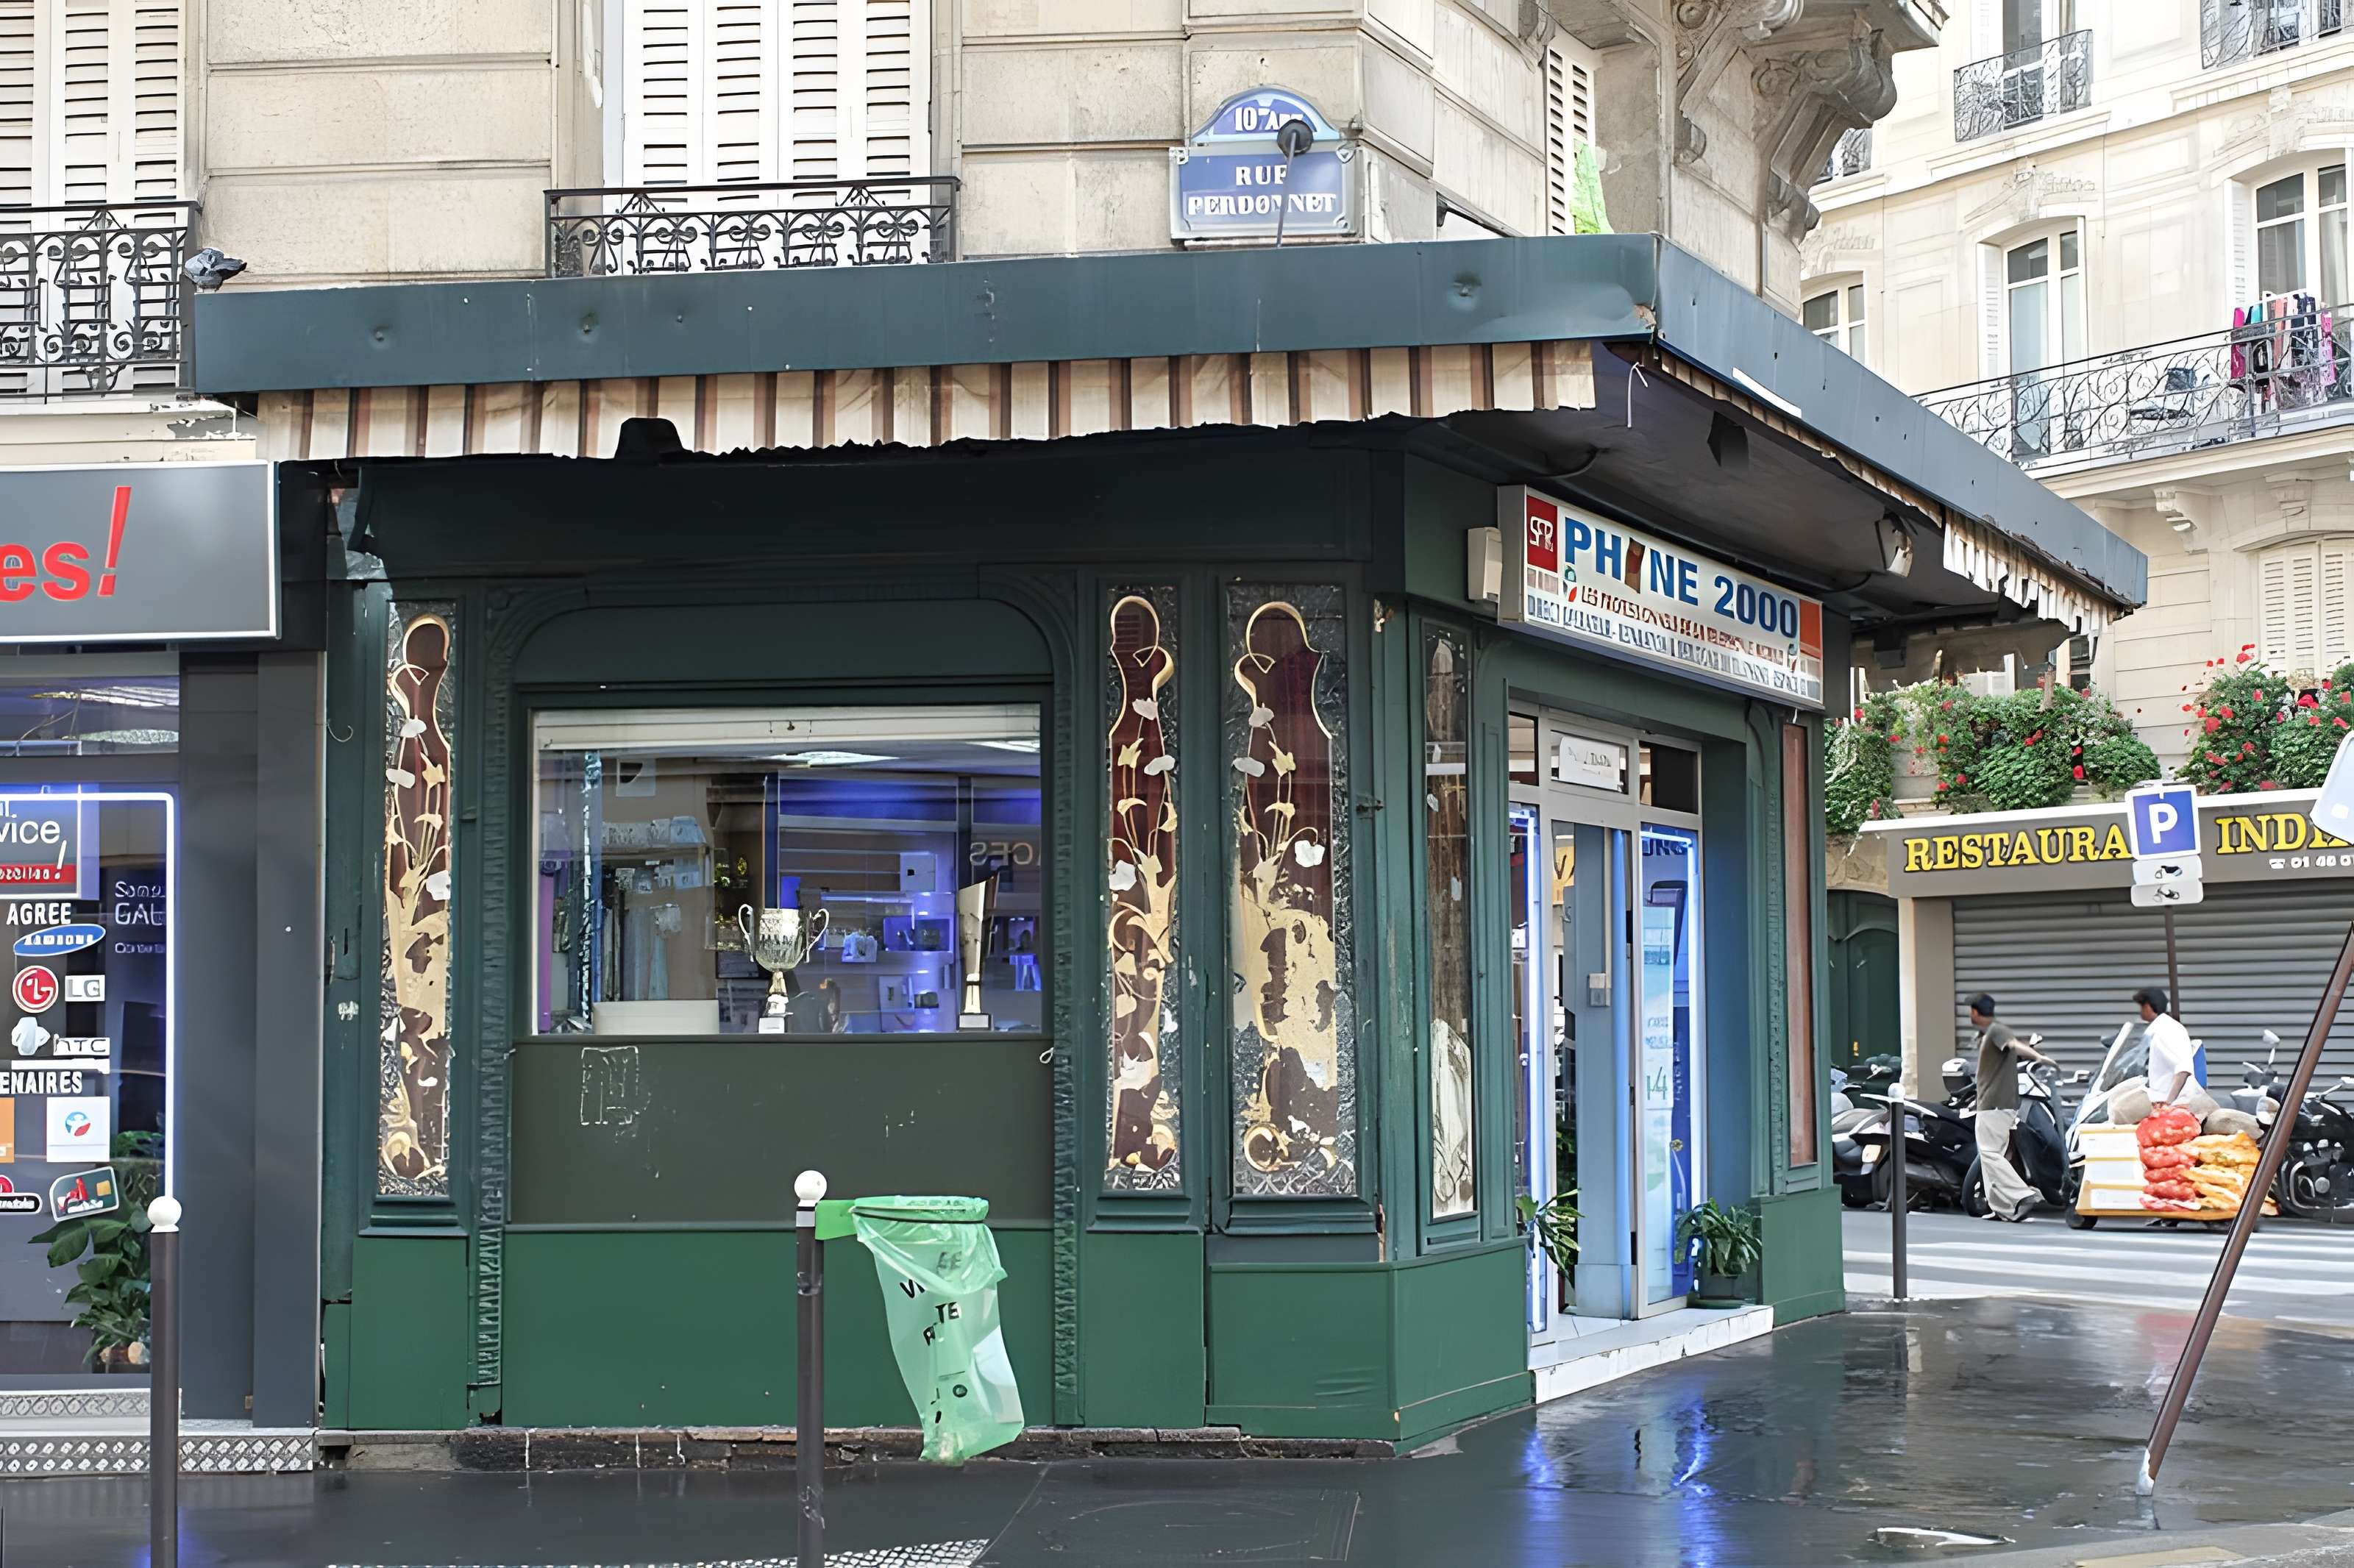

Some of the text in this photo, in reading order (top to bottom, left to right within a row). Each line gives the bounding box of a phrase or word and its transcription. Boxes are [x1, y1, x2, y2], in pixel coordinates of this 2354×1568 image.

[1236, 165, 1287, 185] RUE
[1714, 575, 1798, 639] 2000
[2149, 803, 2178, 844] P
[1903, 823, 2133, 873] RESTAURA
[6, 902, 71, 925] AGREE
